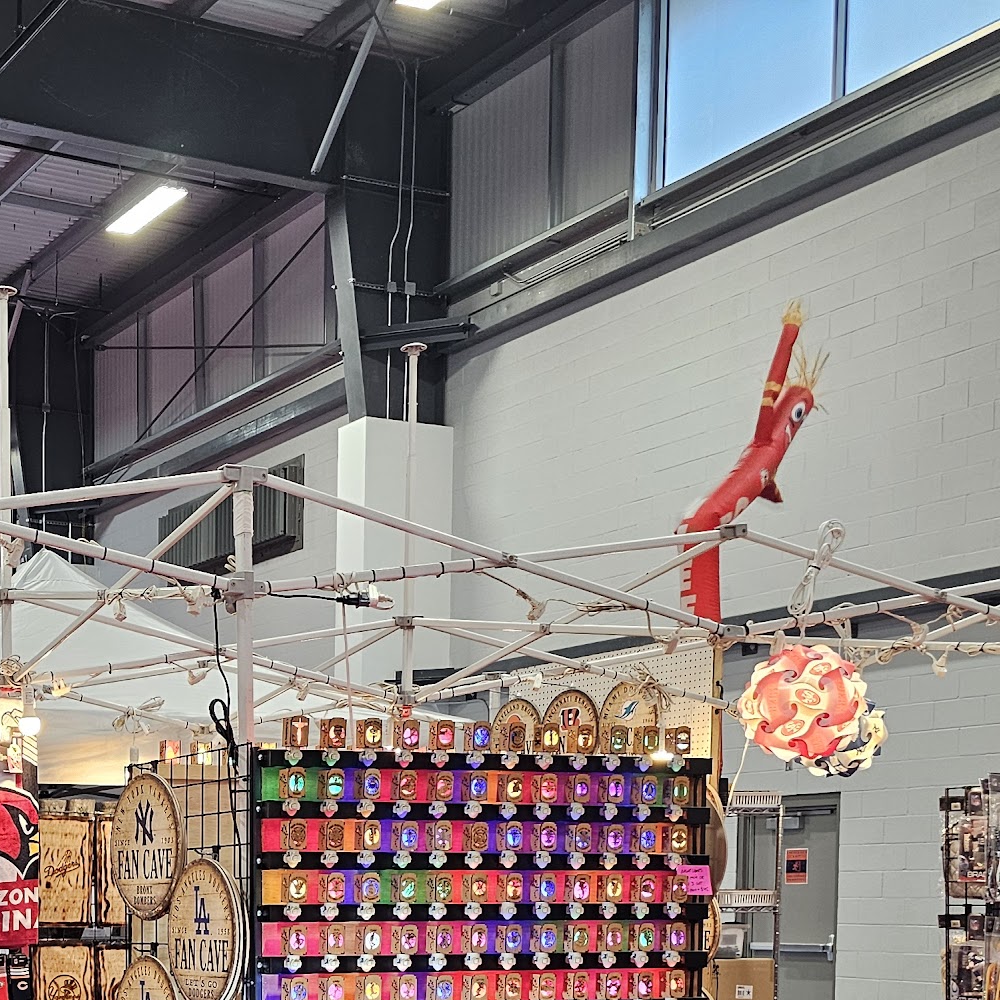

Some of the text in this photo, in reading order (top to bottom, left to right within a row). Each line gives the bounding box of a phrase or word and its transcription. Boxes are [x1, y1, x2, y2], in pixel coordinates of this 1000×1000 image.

[546, 696, 572, 723] INCINNATI
[603, 690, 621, 720] MIAMI
[126, 784, 144, 804] YORK
[150, 785, 175, 830] YANKEES
[134, 799, 154, 846] NY
[118, 848, 173, 880] FAN CAVE
[136, 885, 152, 894] BRONX
[172, 897, 181, 921] LOS
[181, 870, 206, 896] ANGELES
[194, 886, 210, 935] LA
[172, 926, 187, 934] SINCE
[174, 938, 229, 973] FAN CAVE
[128, 966, 151, 987] ANGELES
[208, 980, 218, 988] GO
